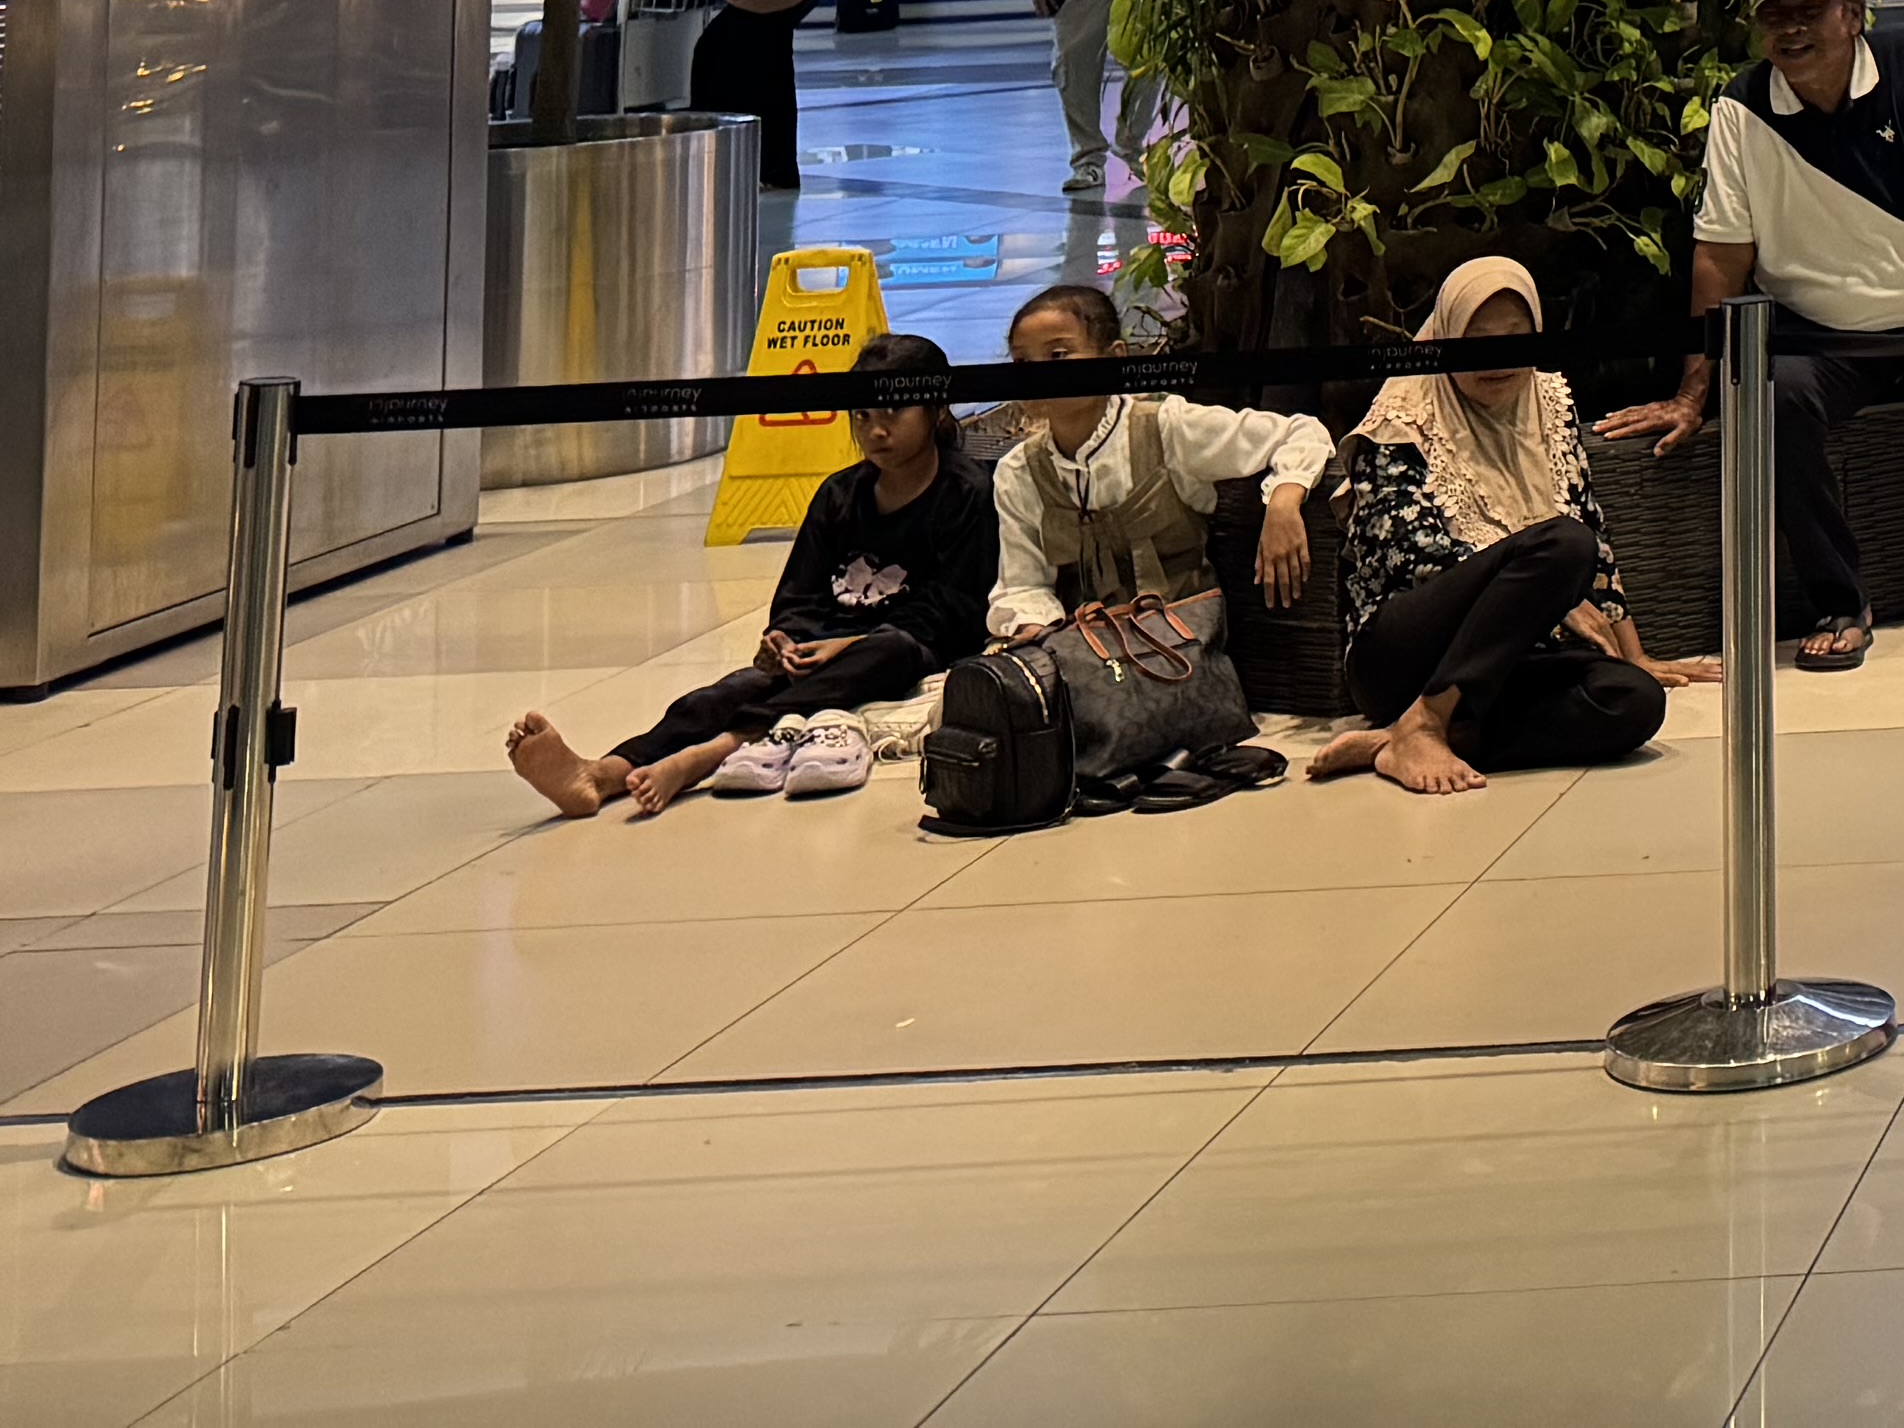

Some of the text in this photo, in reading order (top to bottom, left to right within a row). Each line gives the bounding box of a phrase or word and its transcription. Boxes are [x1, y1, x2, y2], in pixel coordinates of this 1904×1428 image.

[776, 317, 847, 334] CAUTION
[766, 332, 852, 350] WET FLOOR
